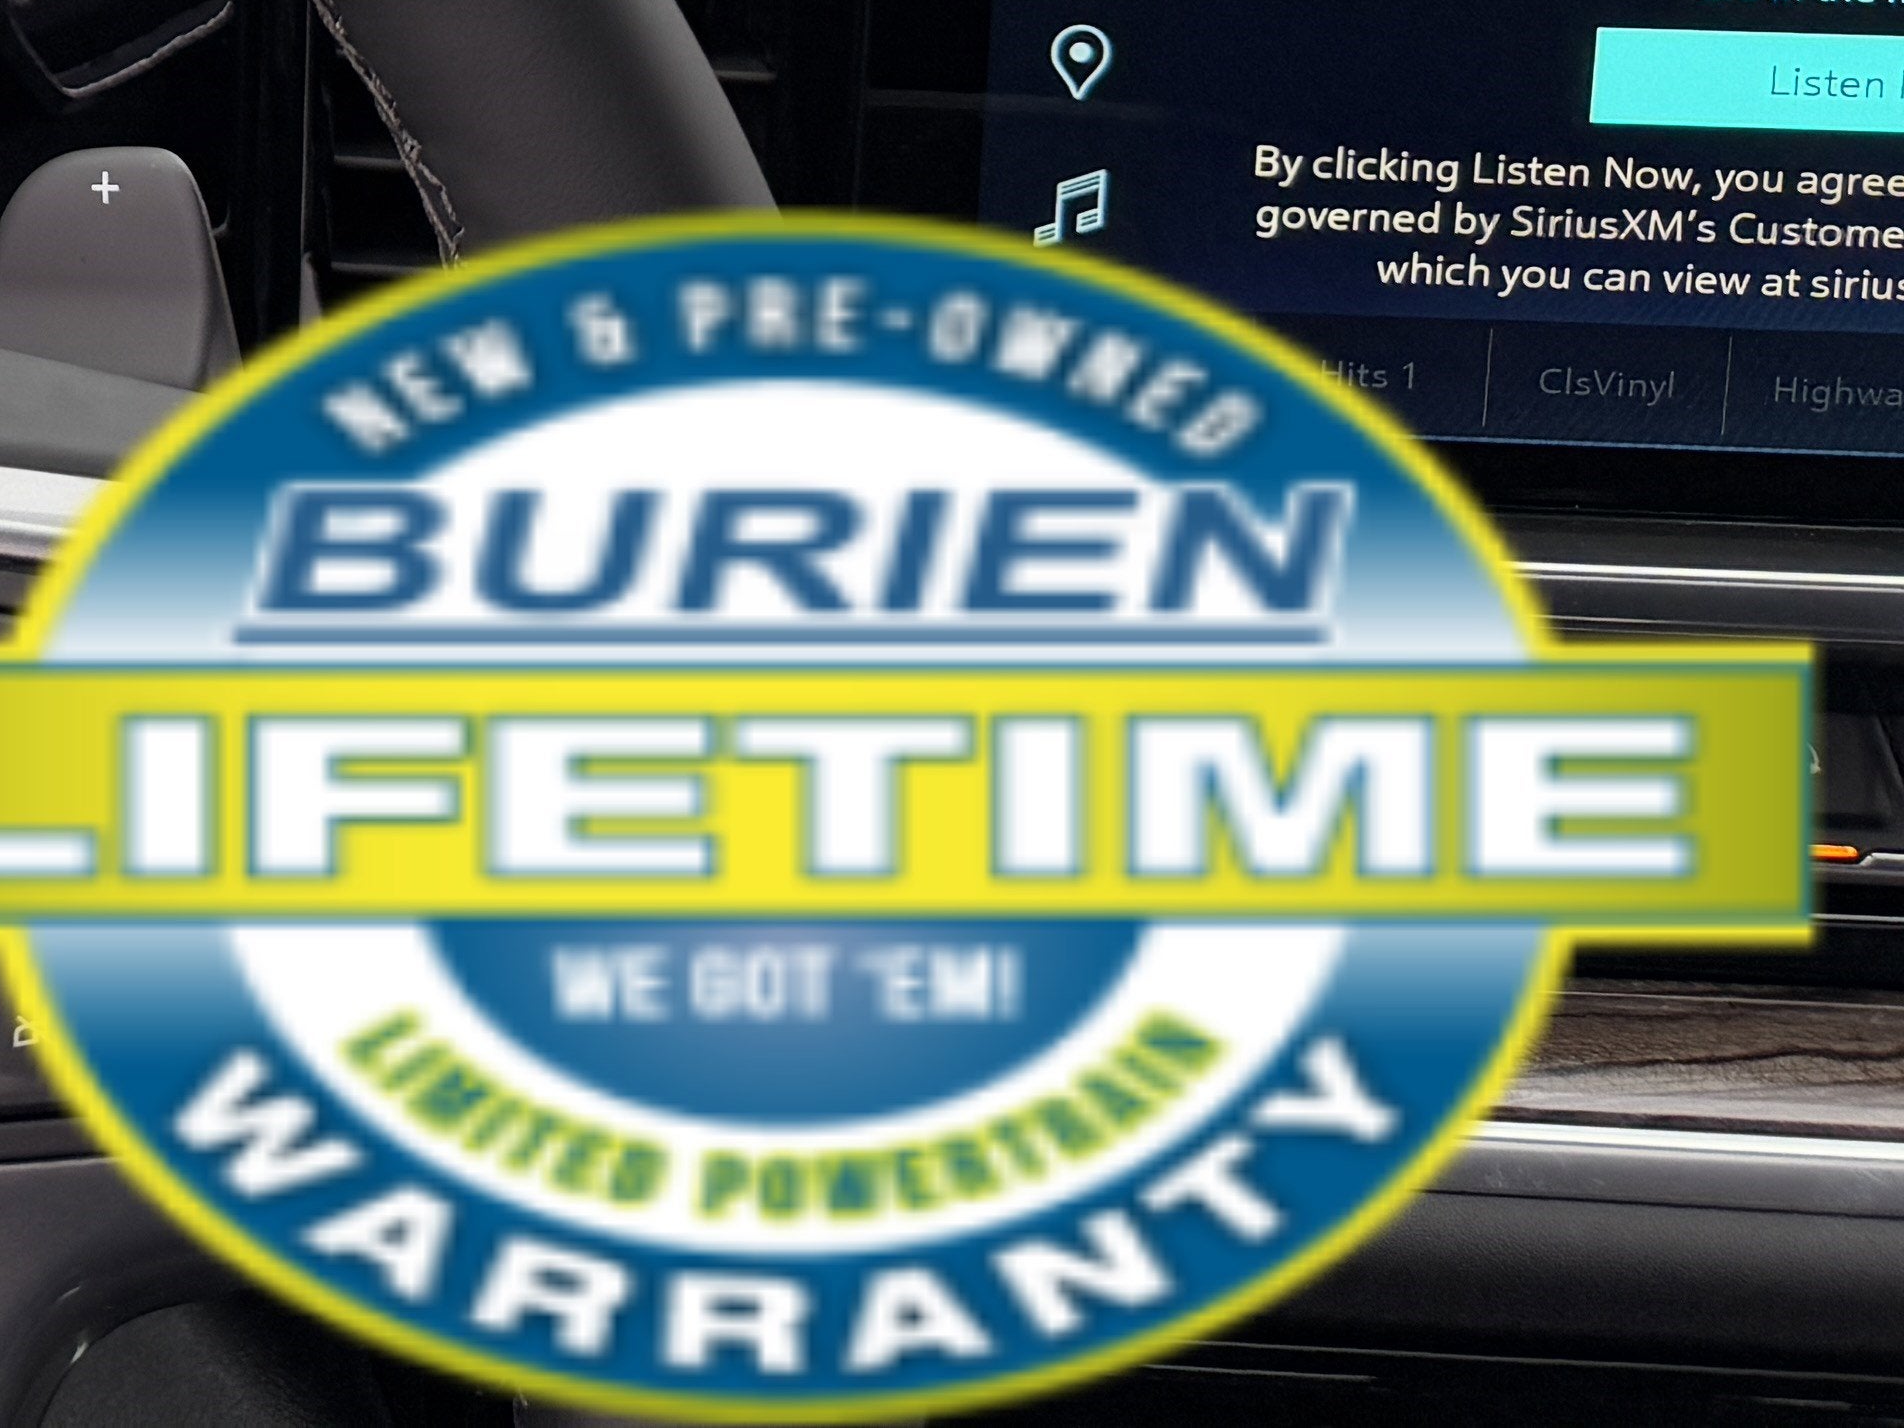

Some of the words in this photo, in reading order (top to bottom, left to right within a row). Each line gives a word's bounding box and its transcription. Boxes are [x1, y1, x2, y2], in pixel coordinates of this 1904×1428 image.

[1770, 64, 1884, 99] Listen
[1253, 144, 1304, 187] By
[1311, 145, 1460, 193] clicking
[1472, 151, 1591, 187] Listen
[1603, 156, 1702, 197] Now,
[1711, 168, 1784, 202] you
[1796, 171, 1904, 206] agree
[1255, 200, 1442, 239] governed
[1453, 200, 1501, 245] by
[1509, 204, 1717, 243] SiriusXM's
[1729, 211, 1904, 249] Custome
[1376, 251, 1490, 288] which
[1497, 264, 1571, 298] you
[1583, 265, 1651, 293] can
[1662, 263, 1752, 295] view
[1760, 268, 1802, 298] at
[1319, 360, 1389, 390] Hits
[1401, 361, 1415, 389] 1
[1539, 367, 1676, 407] ClsVinyl
[1774, 376, 1904, 413] Highwa
